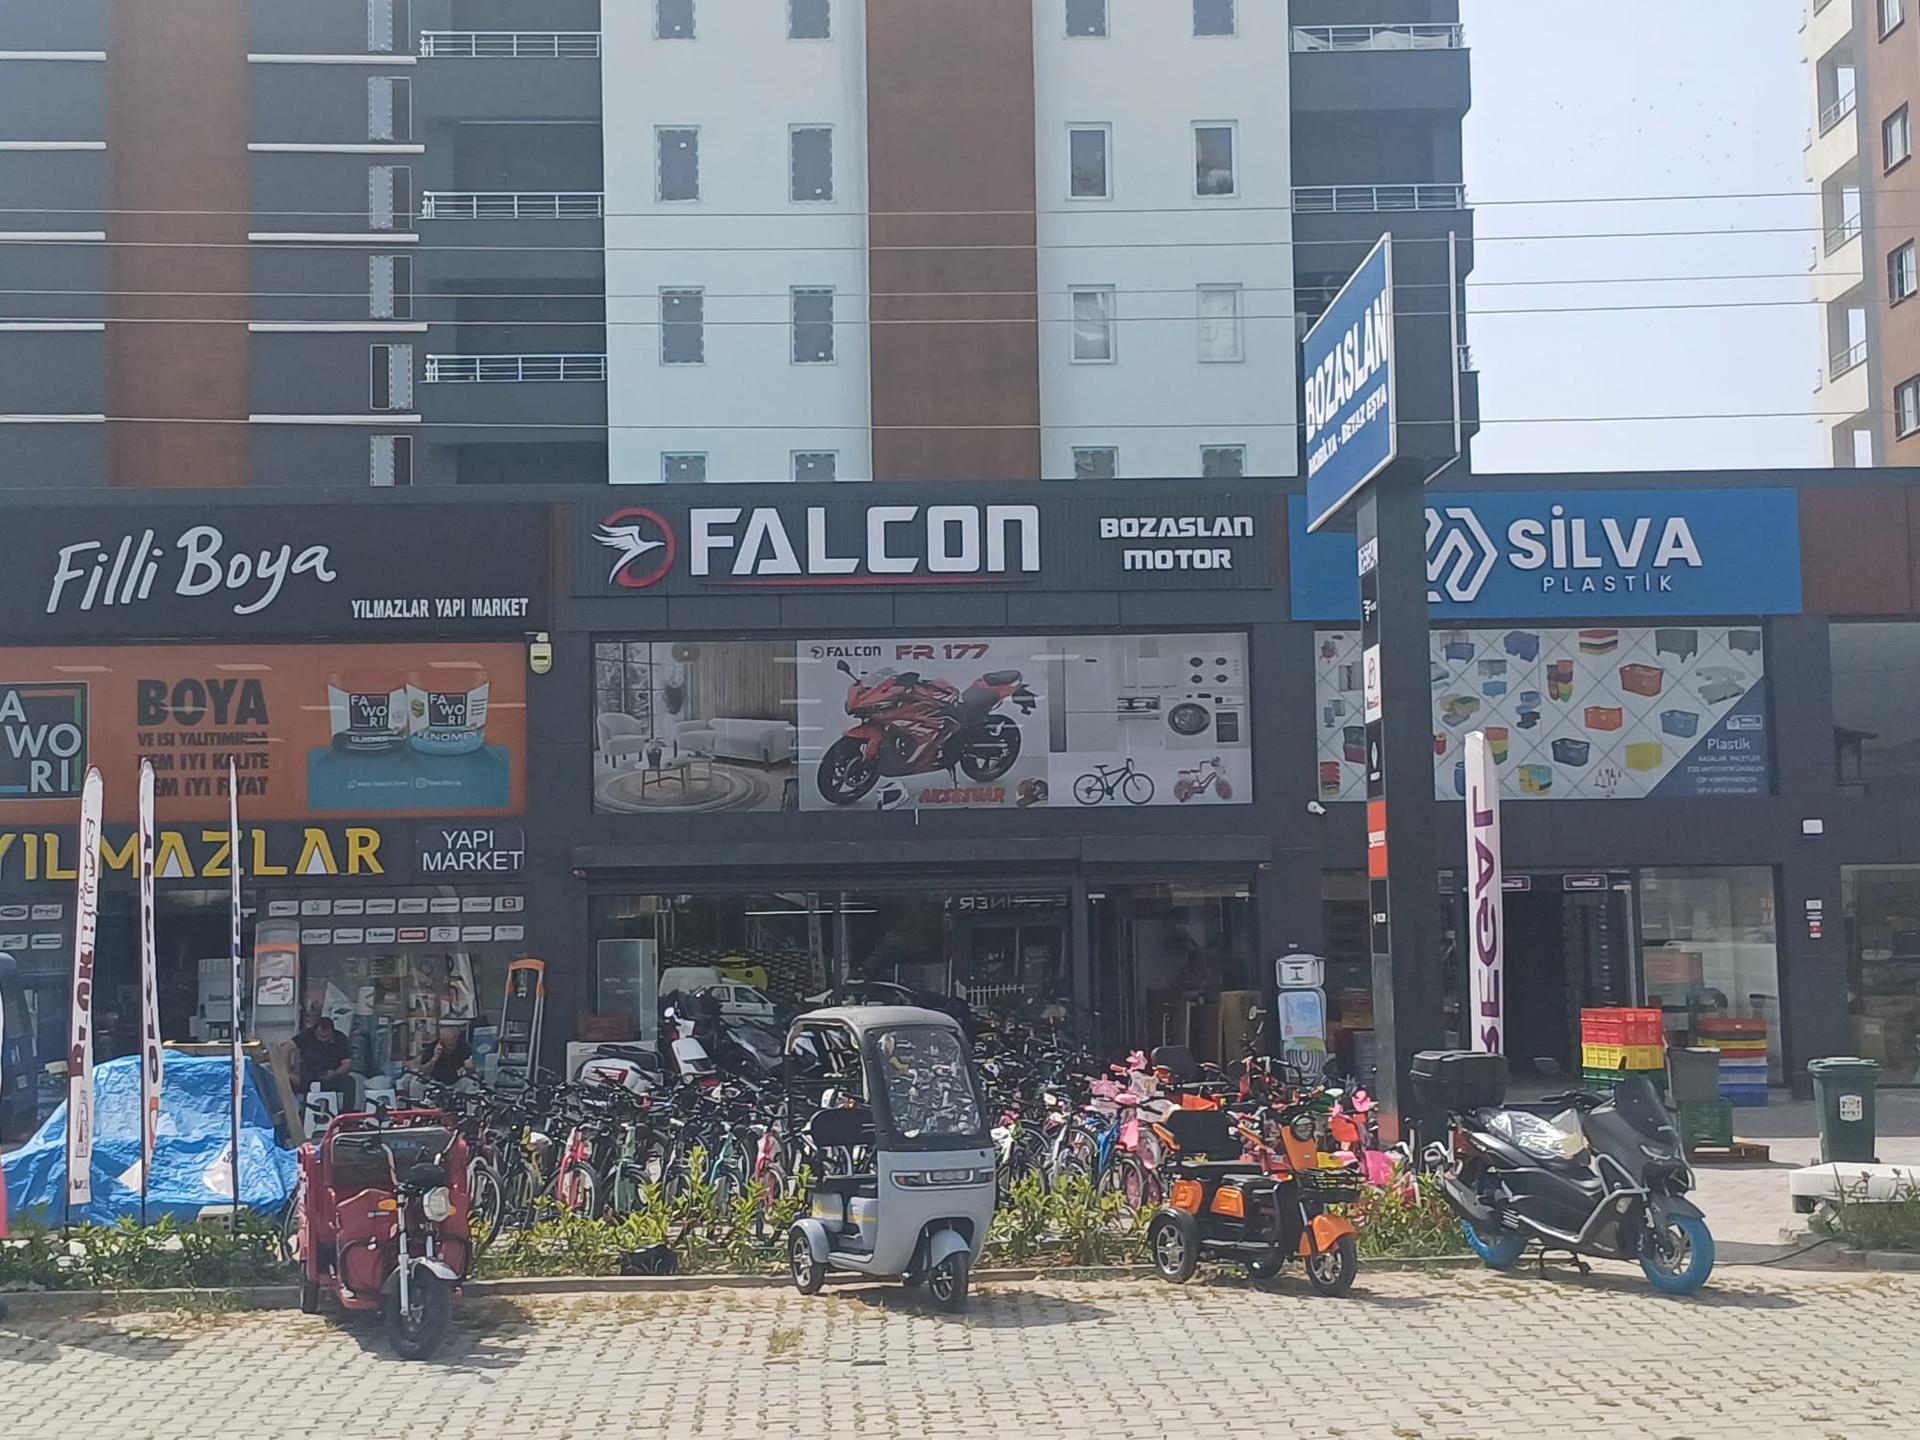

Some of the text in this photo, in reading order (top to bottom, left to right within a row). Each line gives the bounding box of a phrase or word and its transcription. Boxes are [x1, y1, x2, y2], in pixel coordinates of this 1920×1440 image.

[1305, 289, 1388, 443] BOZASLAN
[1100, 516, 1253, 538] BOZASLAN
[1507, 504, 1703, 570] SİLVA
[690, 505, 1039, 576] FALCON
[1123, 549, 1232, 570] MOTOR
[47, 526, 337, 615] Filli Boya
[1543, 572, 1672, 592] PLASTİK
[351, 598, 528, 618] YILMAZLAR YAPI MARKET
[827, 645, 881, 657] FALCON
[896, 643, 989, 660] FR 177
[137, 679, 269, 726] BOYA
[5, 723, 82, 758] WO
[137, 732, 154, 747] VE
[1707, 738, 1751, 751] Plastik
[31, 760, 69, 793] RI
[217, 777, 268, 797] FYAT
[441, 829, 494, 849] YAPI
[422, 850, 523, 871] MARKET
